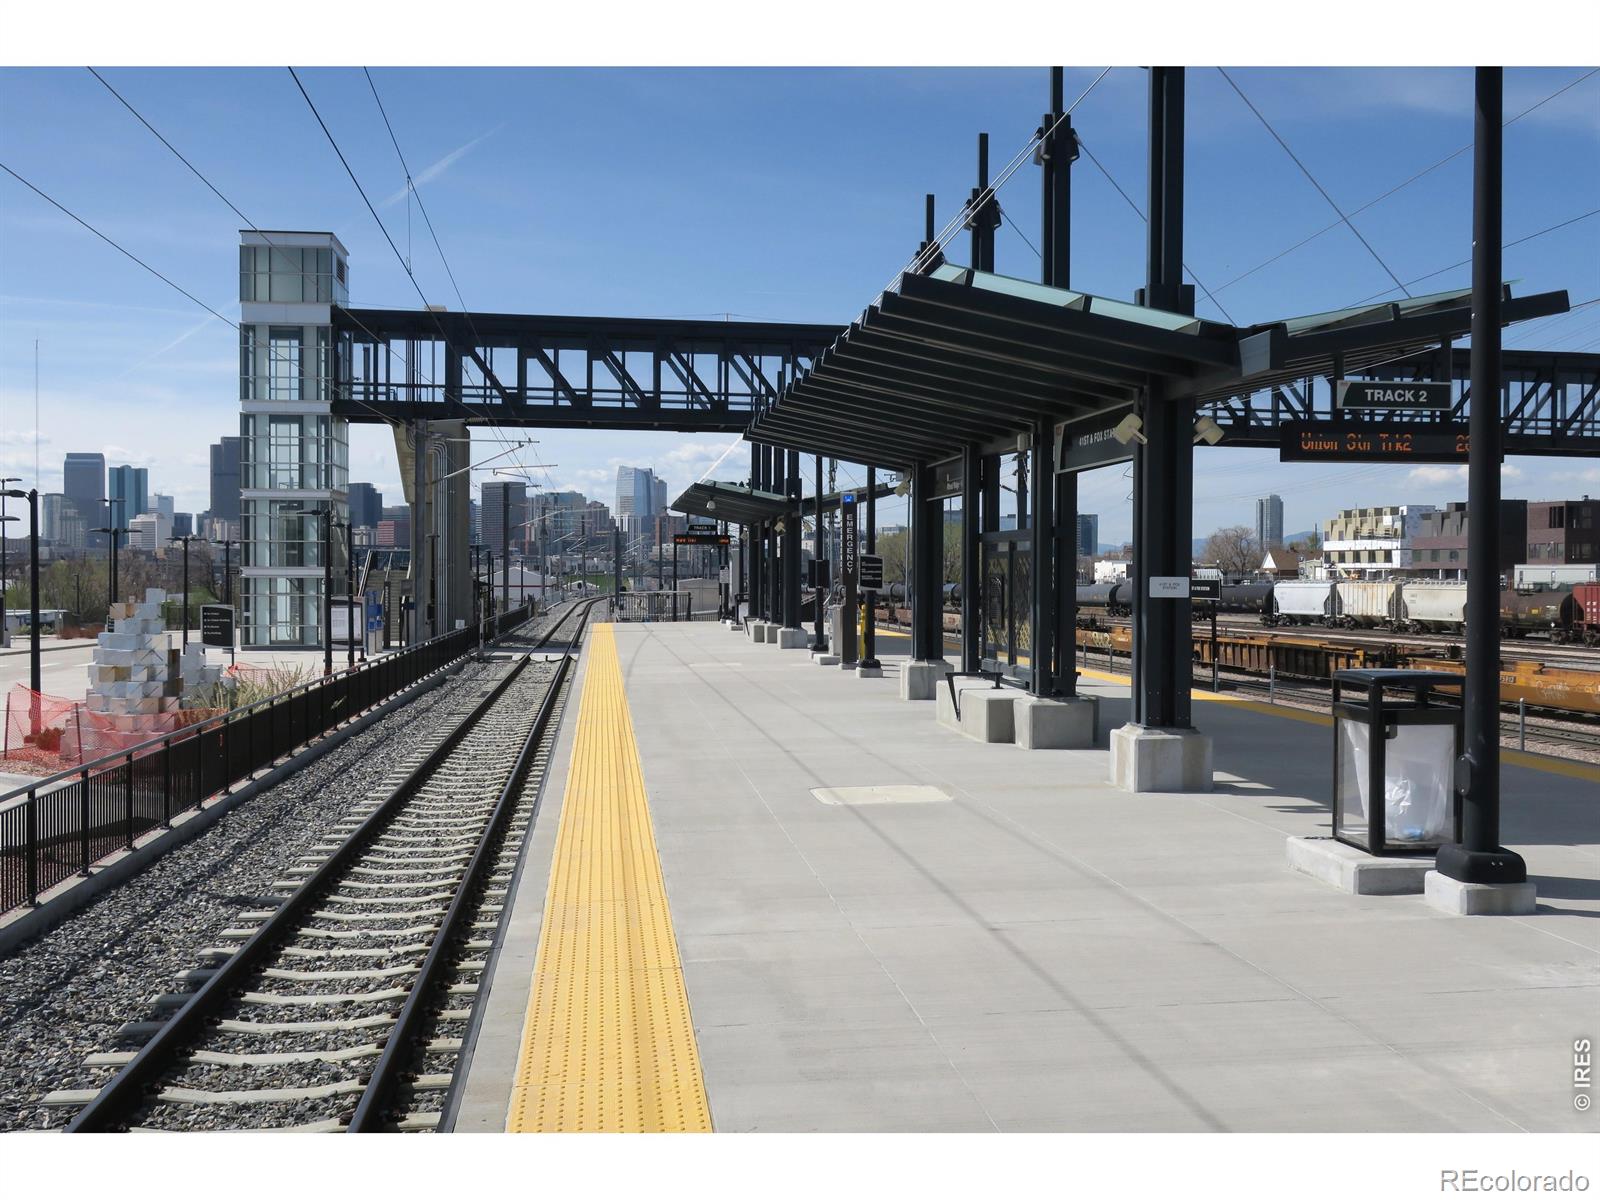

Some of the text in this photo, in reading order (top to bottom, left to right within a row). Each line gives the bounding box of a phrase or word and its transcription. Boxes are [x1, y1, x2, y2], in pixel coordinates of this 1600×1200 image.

[1364, 388, 1428, 402] TRACK 2
[1094, 430, 1103, 443] FOX
[1301, 432, 1339, 451] Union
[846, 513, 854, 575] EMERGENCY
